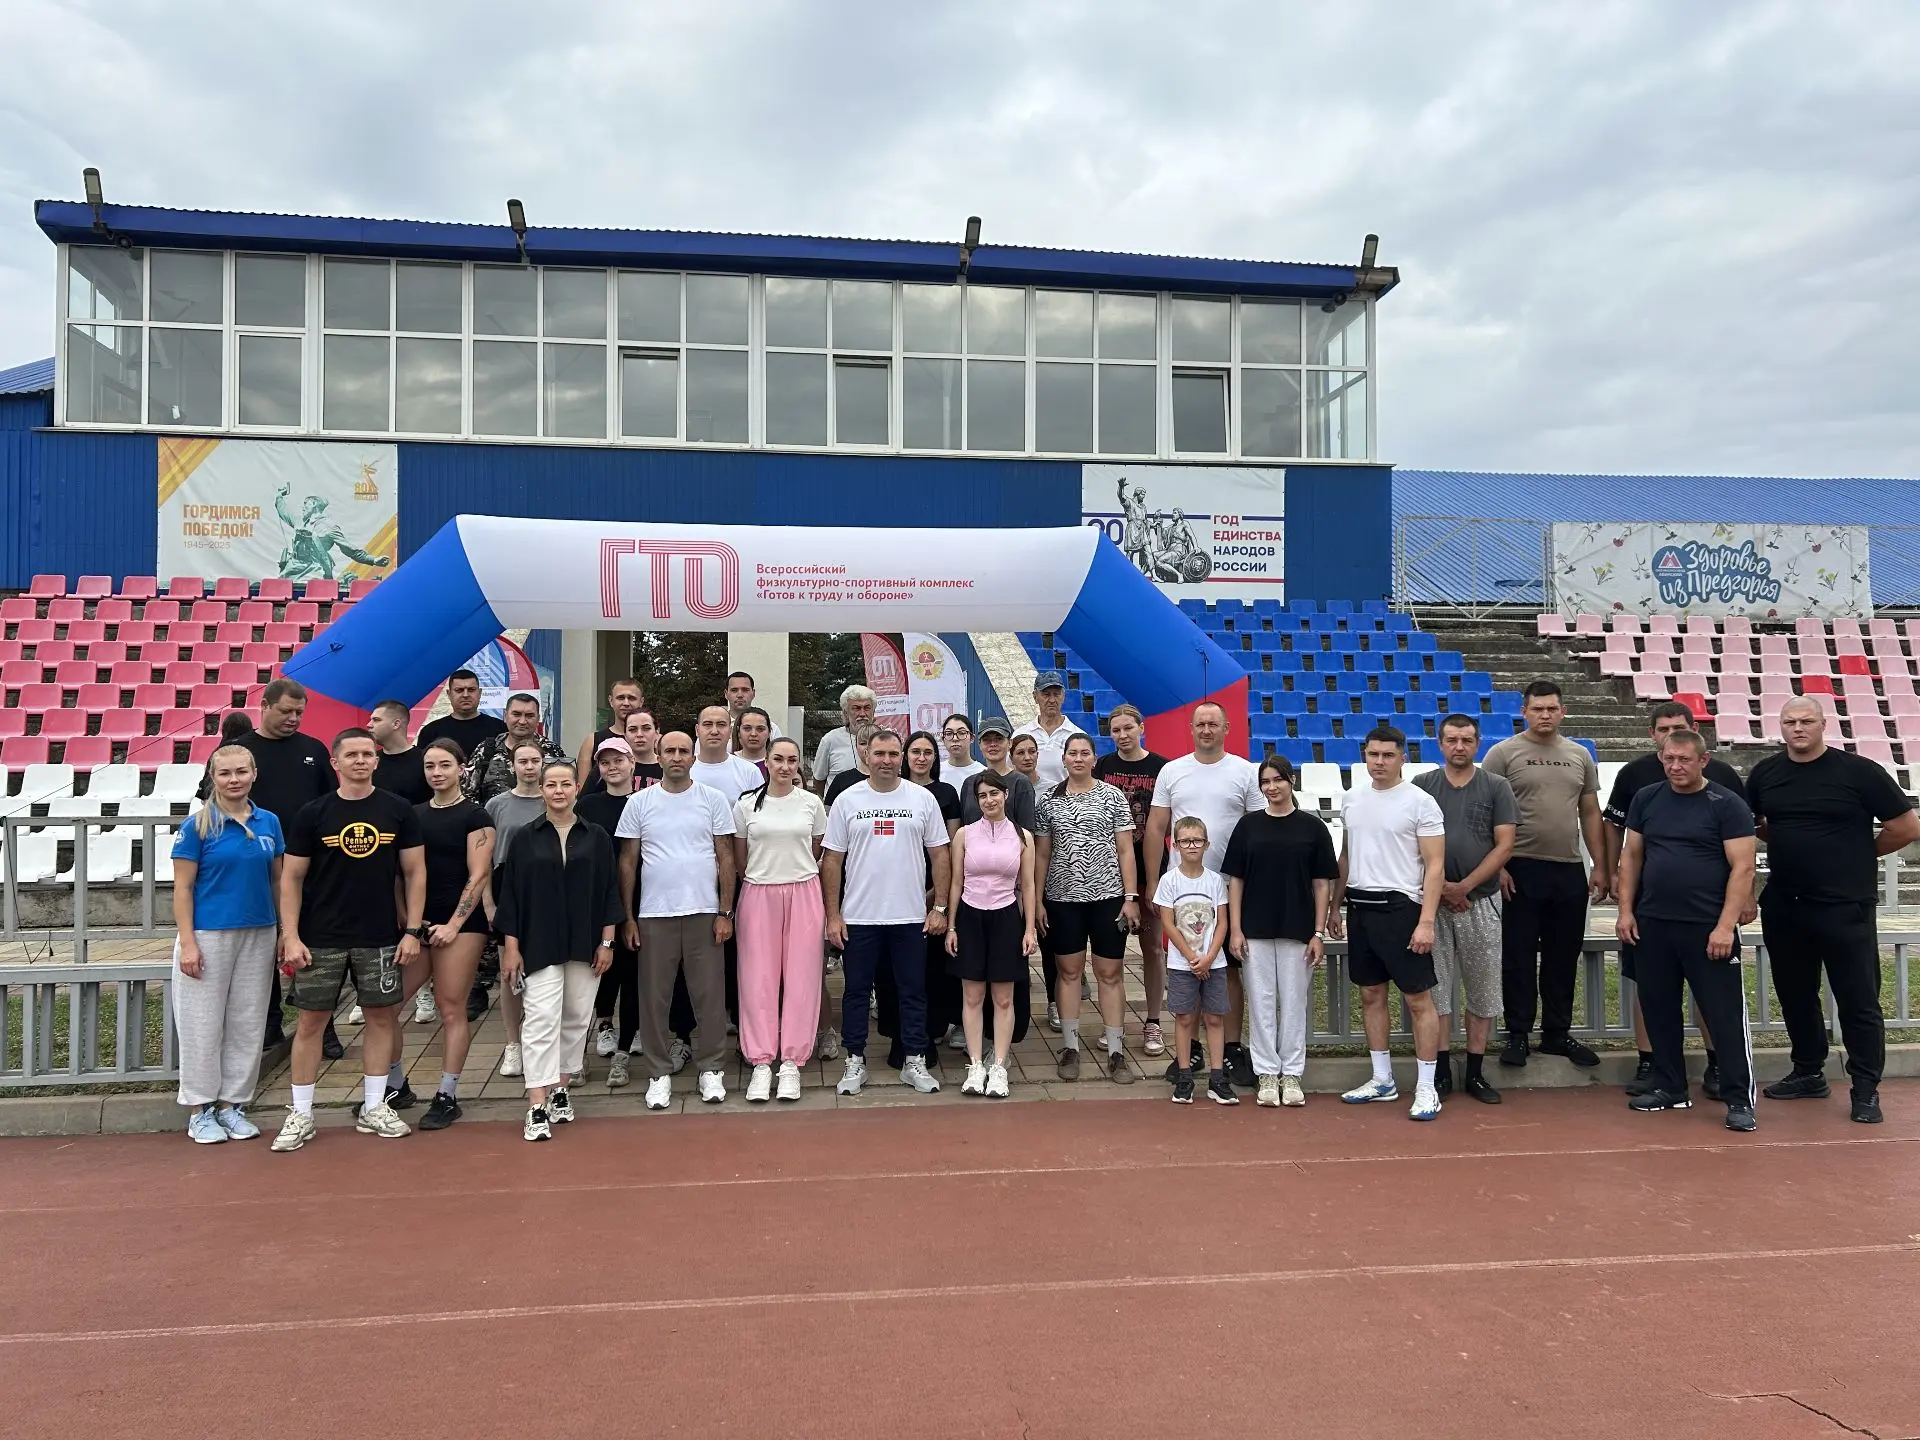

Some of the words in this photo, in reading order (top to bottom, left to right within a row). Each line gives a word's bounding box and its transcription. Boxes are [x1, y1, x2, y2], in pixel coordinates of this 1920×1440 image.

[183, 504, 260, 521] ГОРДИМСЯ
[1213, 515, 1239, 527] ГОД
[183, 521, 254, 539] ПОБЕДОЙ!
[1213, 530, 1281, 541] ЕДИНСТВА
[1213, 545, 1275, 558] НАРОДОВ
[1685, 543, 1768, 575] Здоровье
[756, 564, 846, 576] Всероссийский
[1213, 561, 1267, 572] РОССИИ
[600, 538, 740, 619] ГТО
[756, 577, 916, 589] физкультурно-спортивный
[919, 580, 974, 588] комплекс
[1663, 579, 1688, 604] из
[1687, 569, 1779, 600] Предгорья
[756, 590, 795, 600] «Готов
[808, 592, 843, 601] труду
[857, 590, 914, 602] обороне»
[1526, 759, 1571, 767] Kiton
